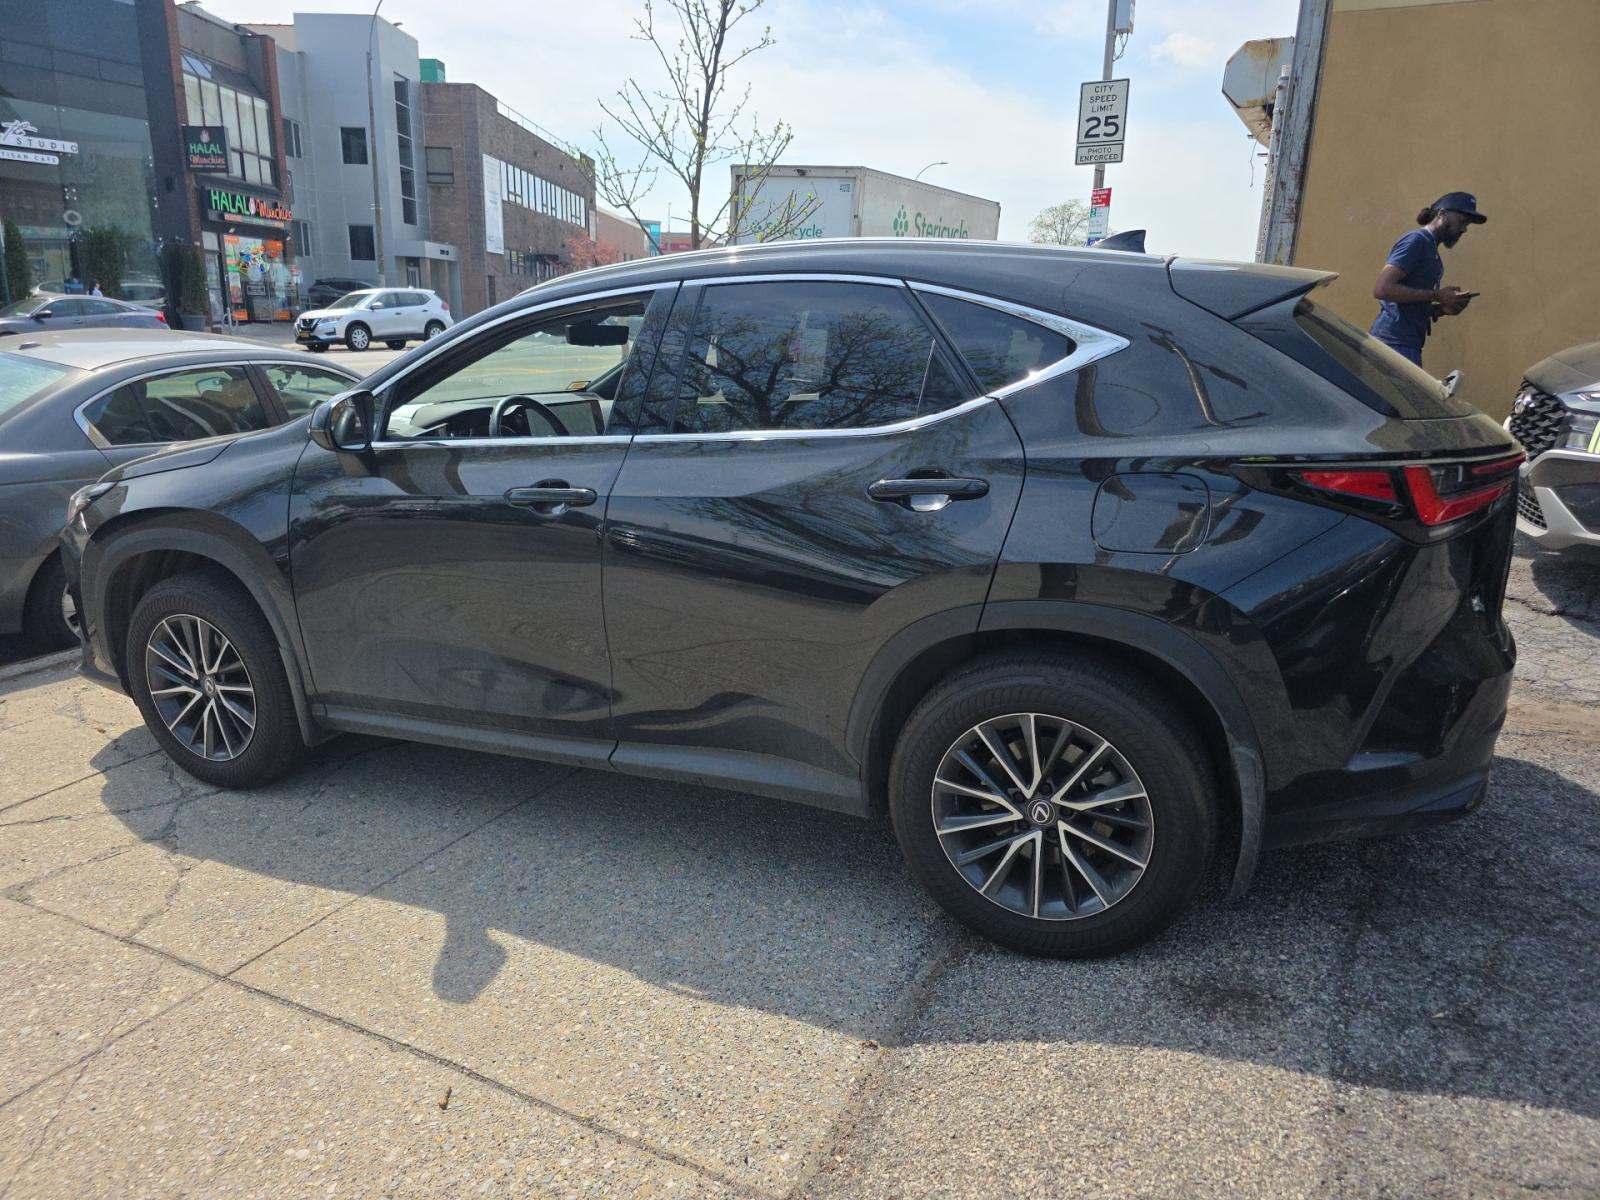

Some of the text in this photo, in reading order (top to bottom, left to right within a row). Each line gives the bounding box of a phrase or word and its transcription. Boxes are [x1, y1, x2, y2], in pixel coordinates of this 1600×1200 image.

[1094, 85, 1114, 93] CITY
[1089, 95, 1118, 103] SPEED
[1091, 104, 1114, 113] LIMIT
[1084, 115, 1119, 138] 25
[16, 137, 78, 152] STUDIO
[189, 143, 224, 155] HALAL
[1079, 153, 1119, 162] ENFORCED
[210, 189, 251, 215] HALAL
